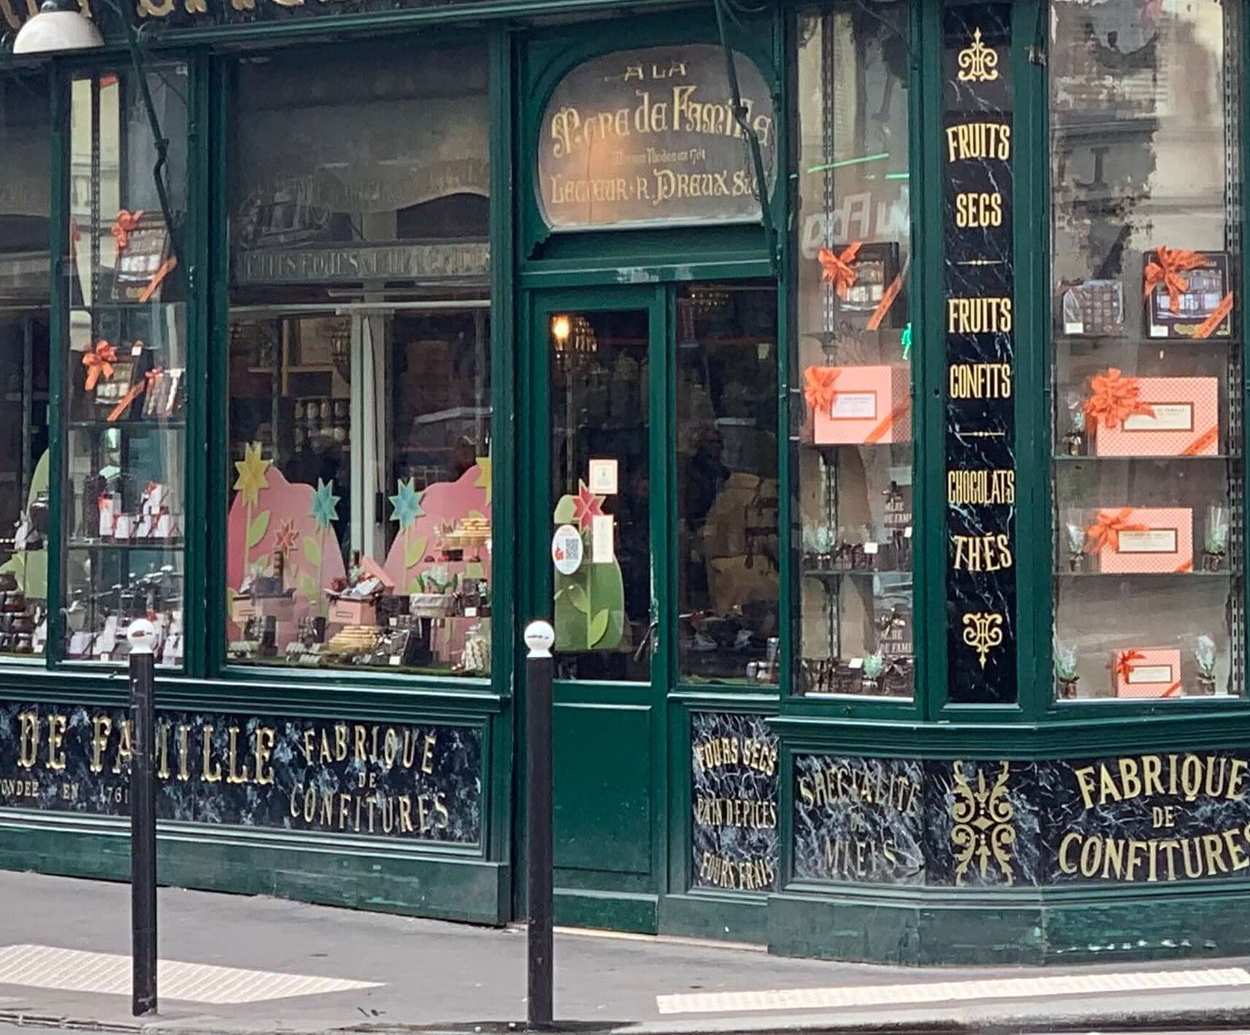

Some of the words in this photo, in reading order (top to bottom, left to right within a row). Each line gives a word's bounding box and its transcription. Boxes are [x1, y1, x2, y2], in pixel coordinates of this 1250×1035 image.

[652, 62, 686, 79] LA
[945, 123, 1010, 163] FRUITS
[956, 192, 1002, 229] SECS
[948, 297, 1012, 334] FRUITS
[949, 364, 1011, 400] CONFITS
[948, 469, 1015, 506] CHOCOLATS
[952, 531, 1012, 572] THÉS
[17, 712, 67, 770] DE
[303, 724, 437, 776] FABRIQUE
[696, 736, 739, 773] FOURS
[743, 737, 777, 776] SECS
[358, 772, 377, 789] DE
[1075, 755, 1248, 810] FABRIQUE
[290, 783, 450, 834] CONFITURES
[1153, 806, 1175, 829] DE
